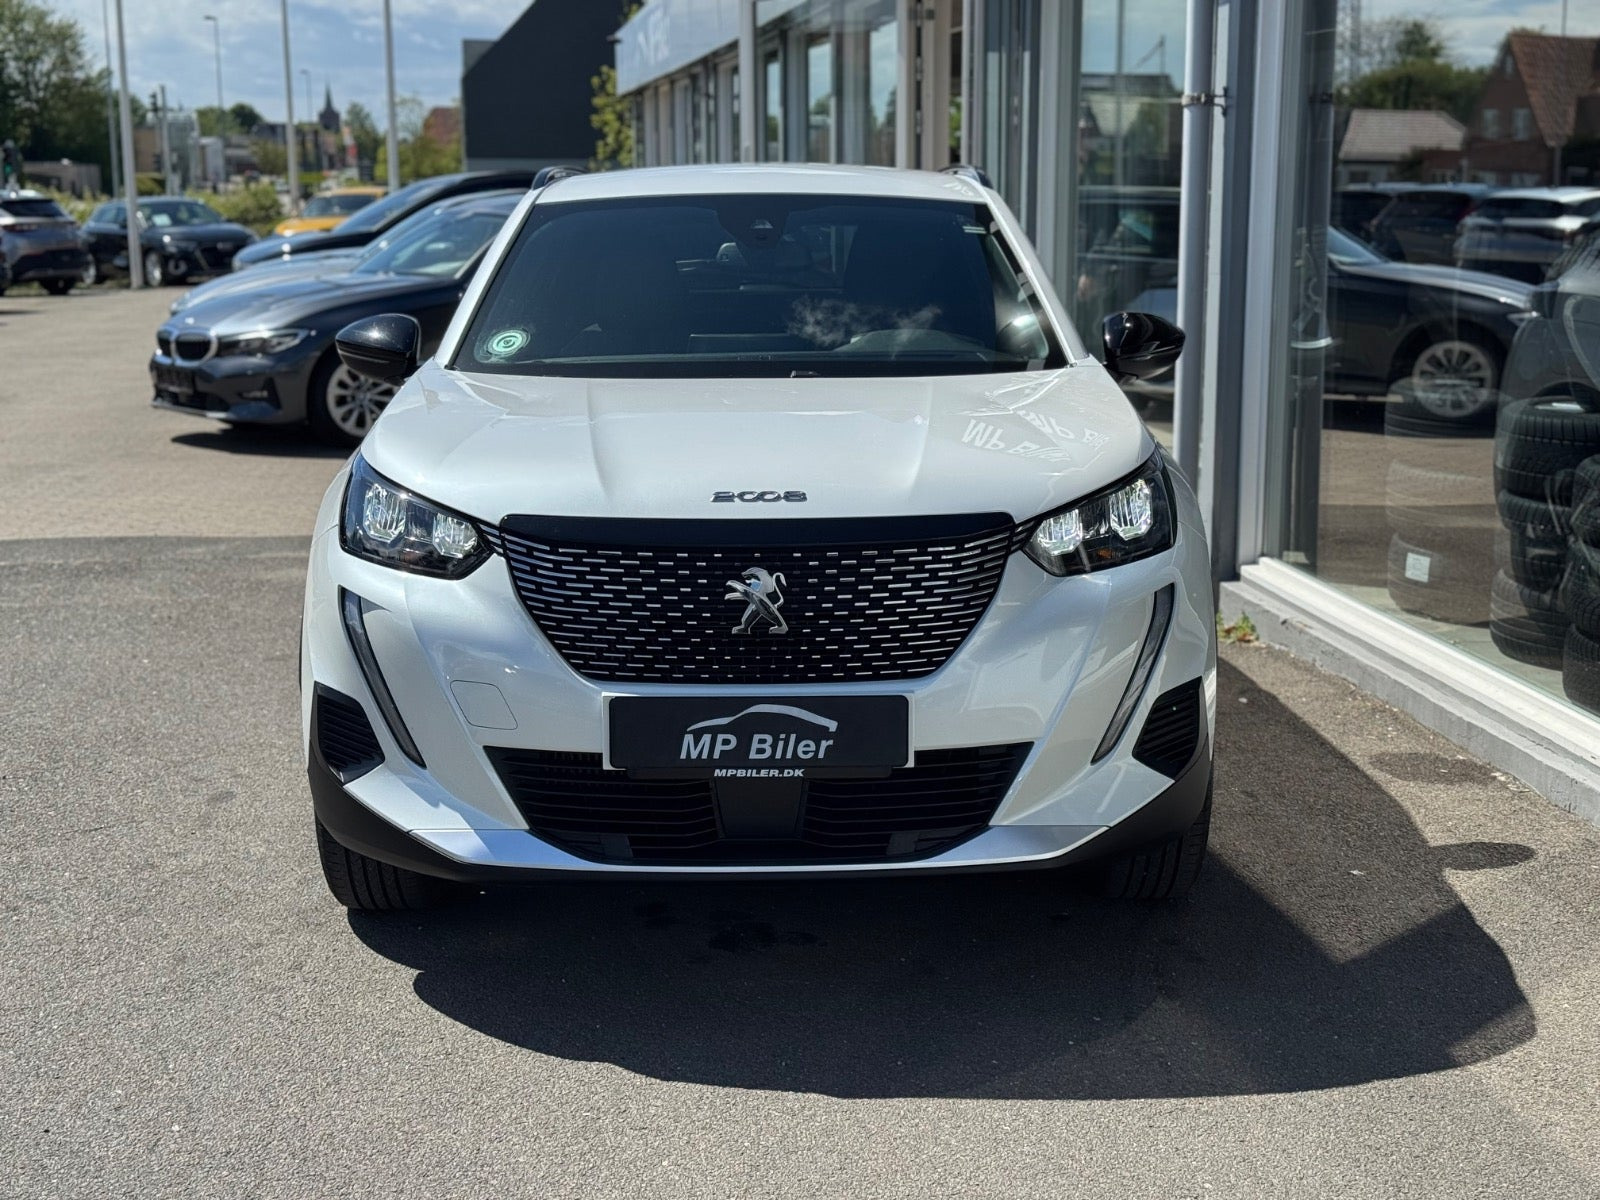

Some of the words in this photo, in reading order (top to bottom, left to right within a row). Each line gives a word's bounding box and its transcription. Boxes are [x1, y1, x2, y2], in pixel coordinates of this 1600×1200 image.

[710, 490, 808, 503] 2008
[679, 733, 737, 760] MP
[748, 733, 834, 760] Biler
[713, 768, 806, 778] MPBILER.DK
